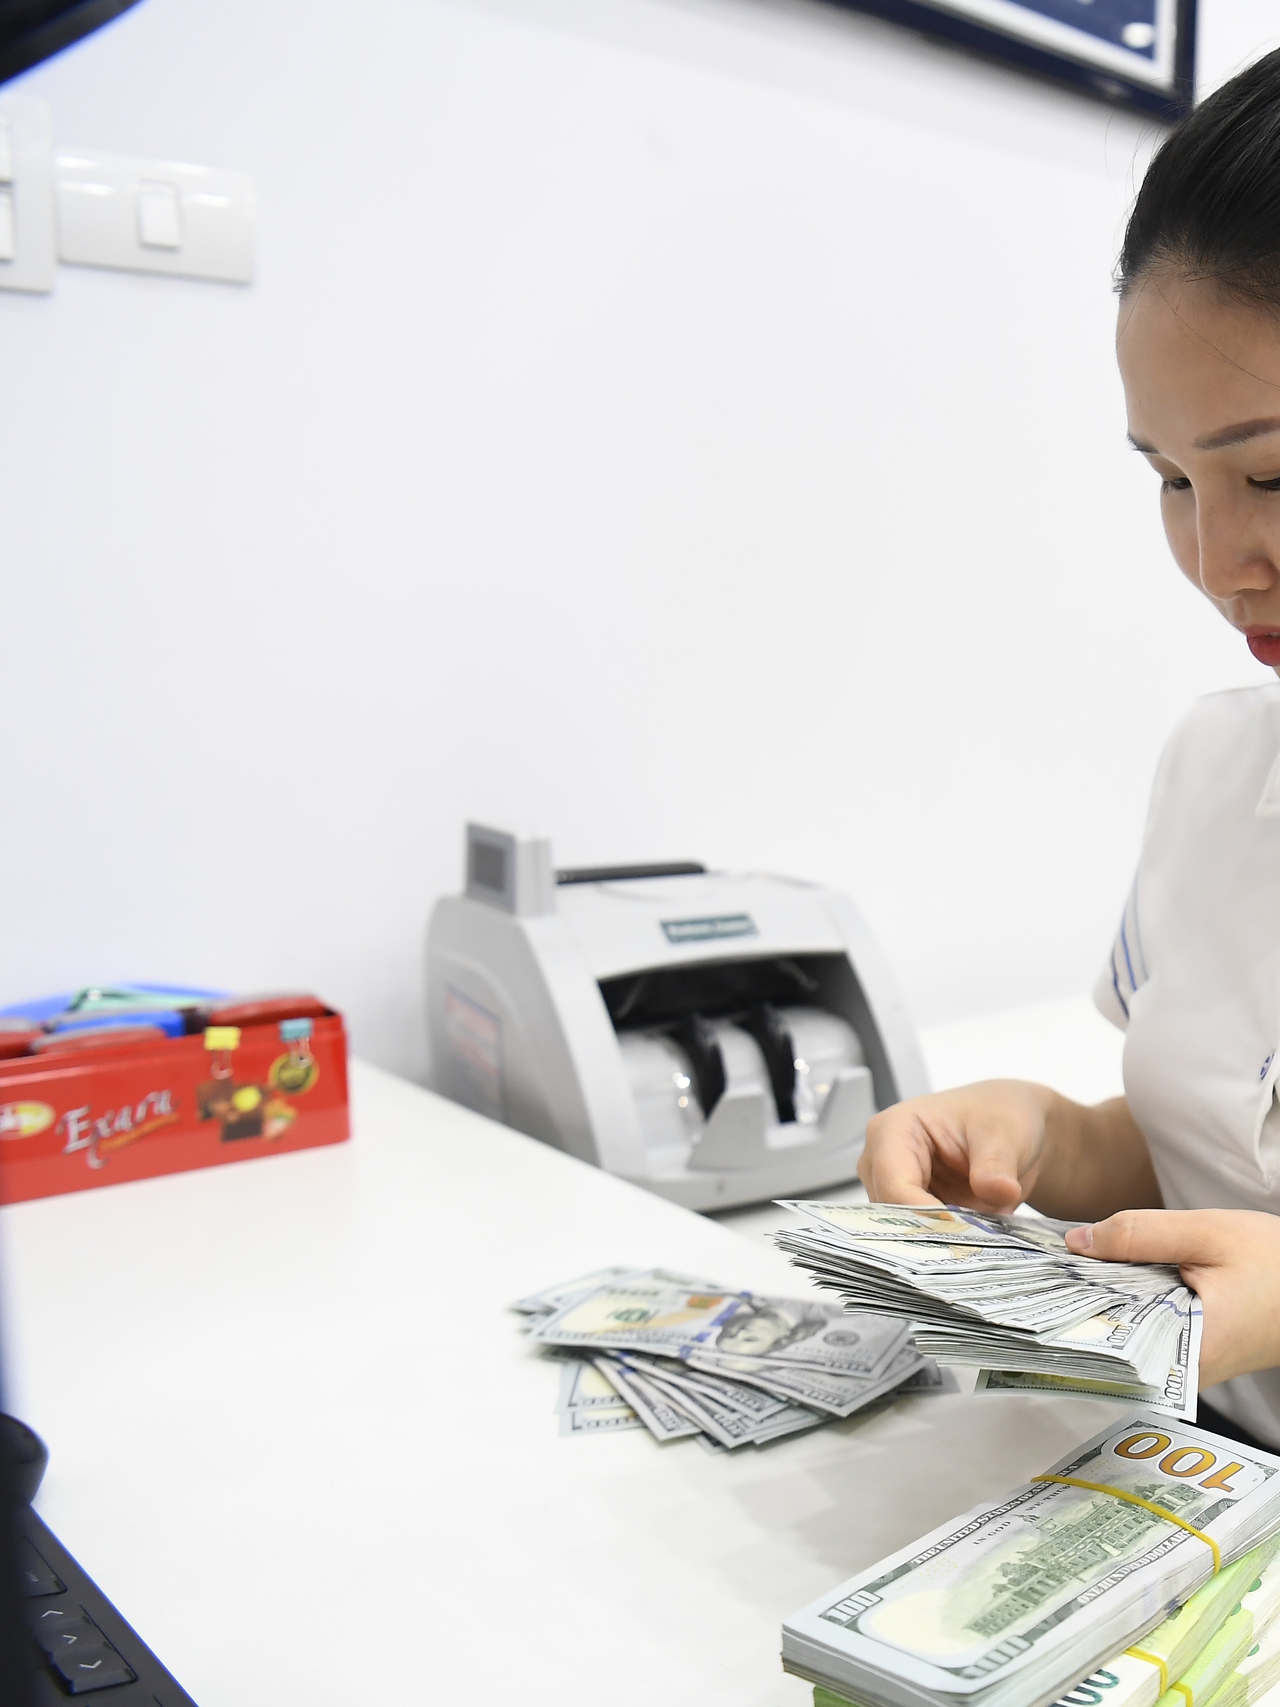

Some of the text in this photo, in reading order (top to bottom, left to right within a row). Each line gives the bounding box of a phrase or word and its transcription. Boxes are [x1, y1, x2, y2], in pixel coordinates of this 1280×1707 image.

[1165, 1367, 1184, 1400] 100
[1114, 1432, 1245, 1493] 100
[912, 1545, 940, 1565] THE
[937, 1521, 982, 1551] UNITED
[979, 1499, 1022, 1526] STATES
[1018, 1489, 1035, 1504] OF
[973, 1484, 1072, 1545] IN GOD WE TRUS
[826, 1589, 882, 1622] 100
[1077, 1583, 1104, 1606] ONE
[1099, 1557, 1152, 1592] HUNDRED
